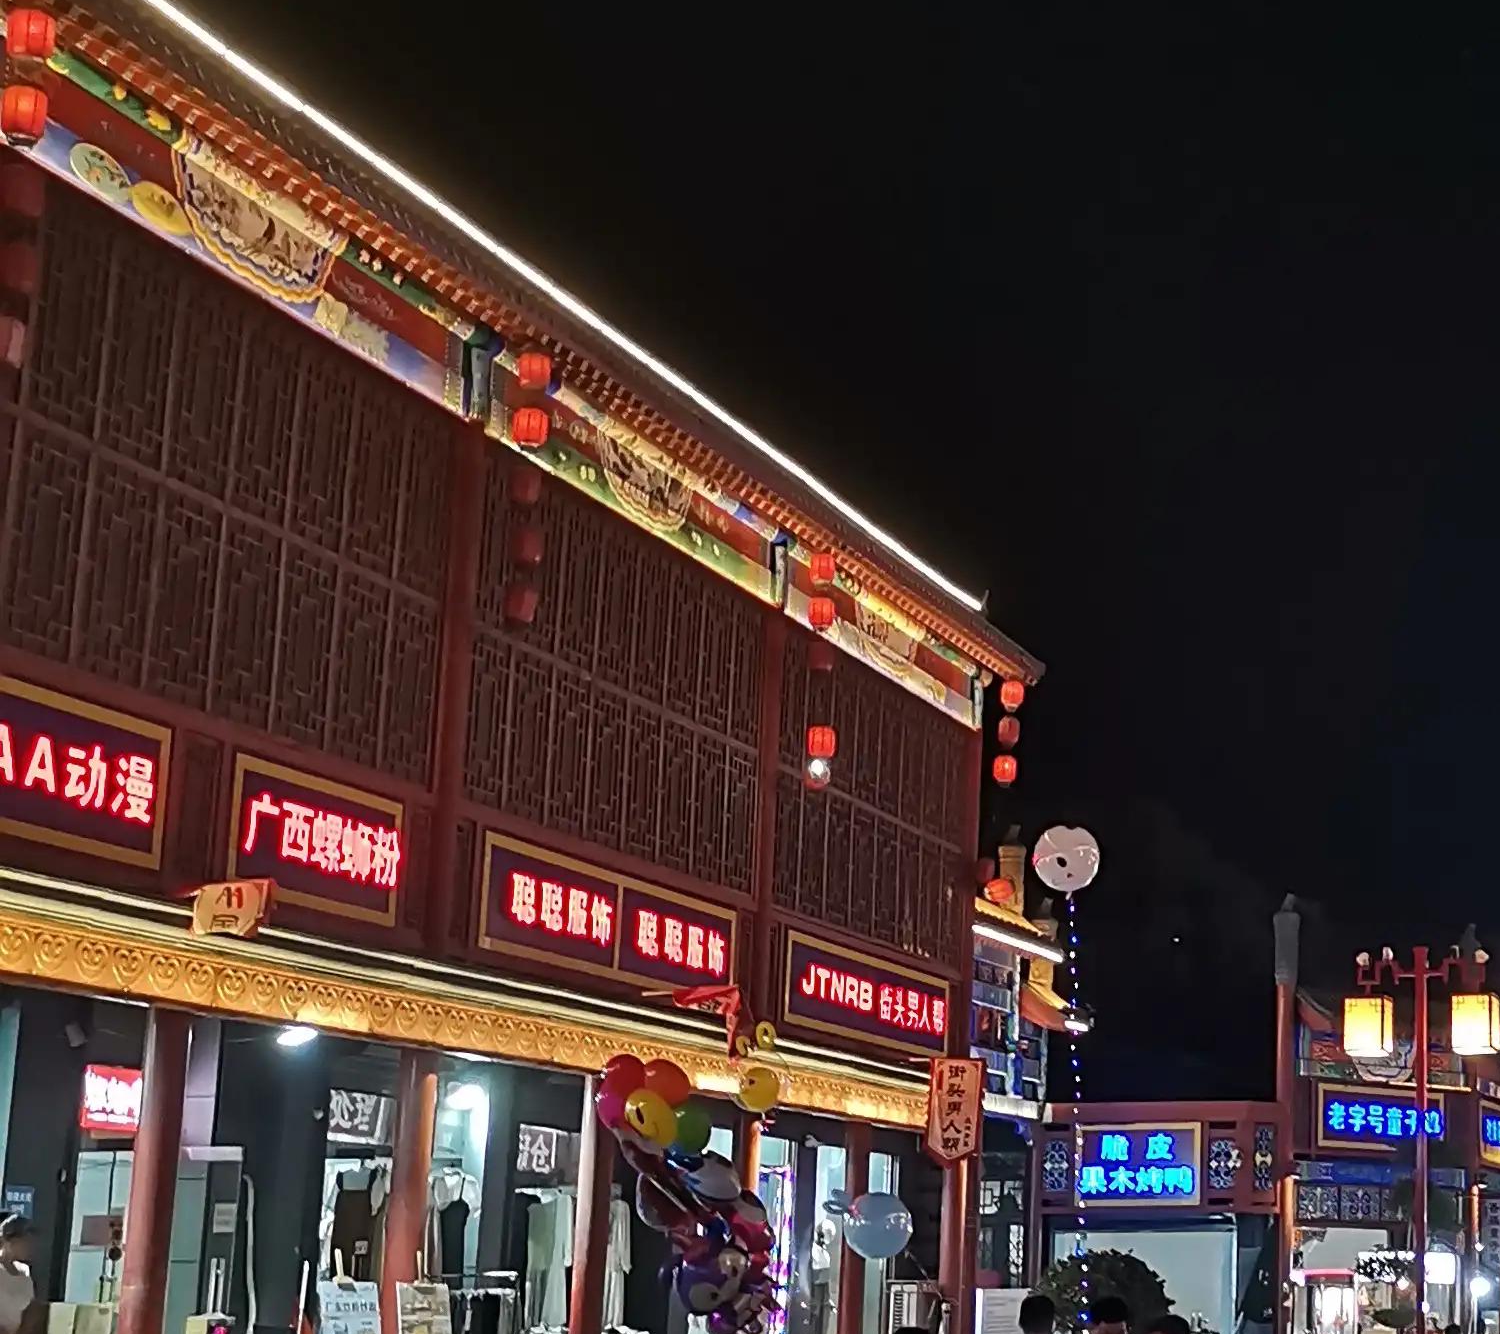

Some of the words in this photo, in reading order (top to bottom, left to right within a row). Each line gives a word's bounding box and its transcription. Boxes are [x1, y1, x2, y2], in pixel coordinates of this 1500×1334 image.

[244, 793, 401, 887] 广西螺蛳粉
[510, 872, 613, 948] 聪聪服饰
[637, 909, 726, 979] 聪聪服饰
[802, 964, 874, 1012] JTNRB
[879, 984, 946, 1035] 街头男人帮
[1079, 1165, 1193, 1195] 果木烤鸭
